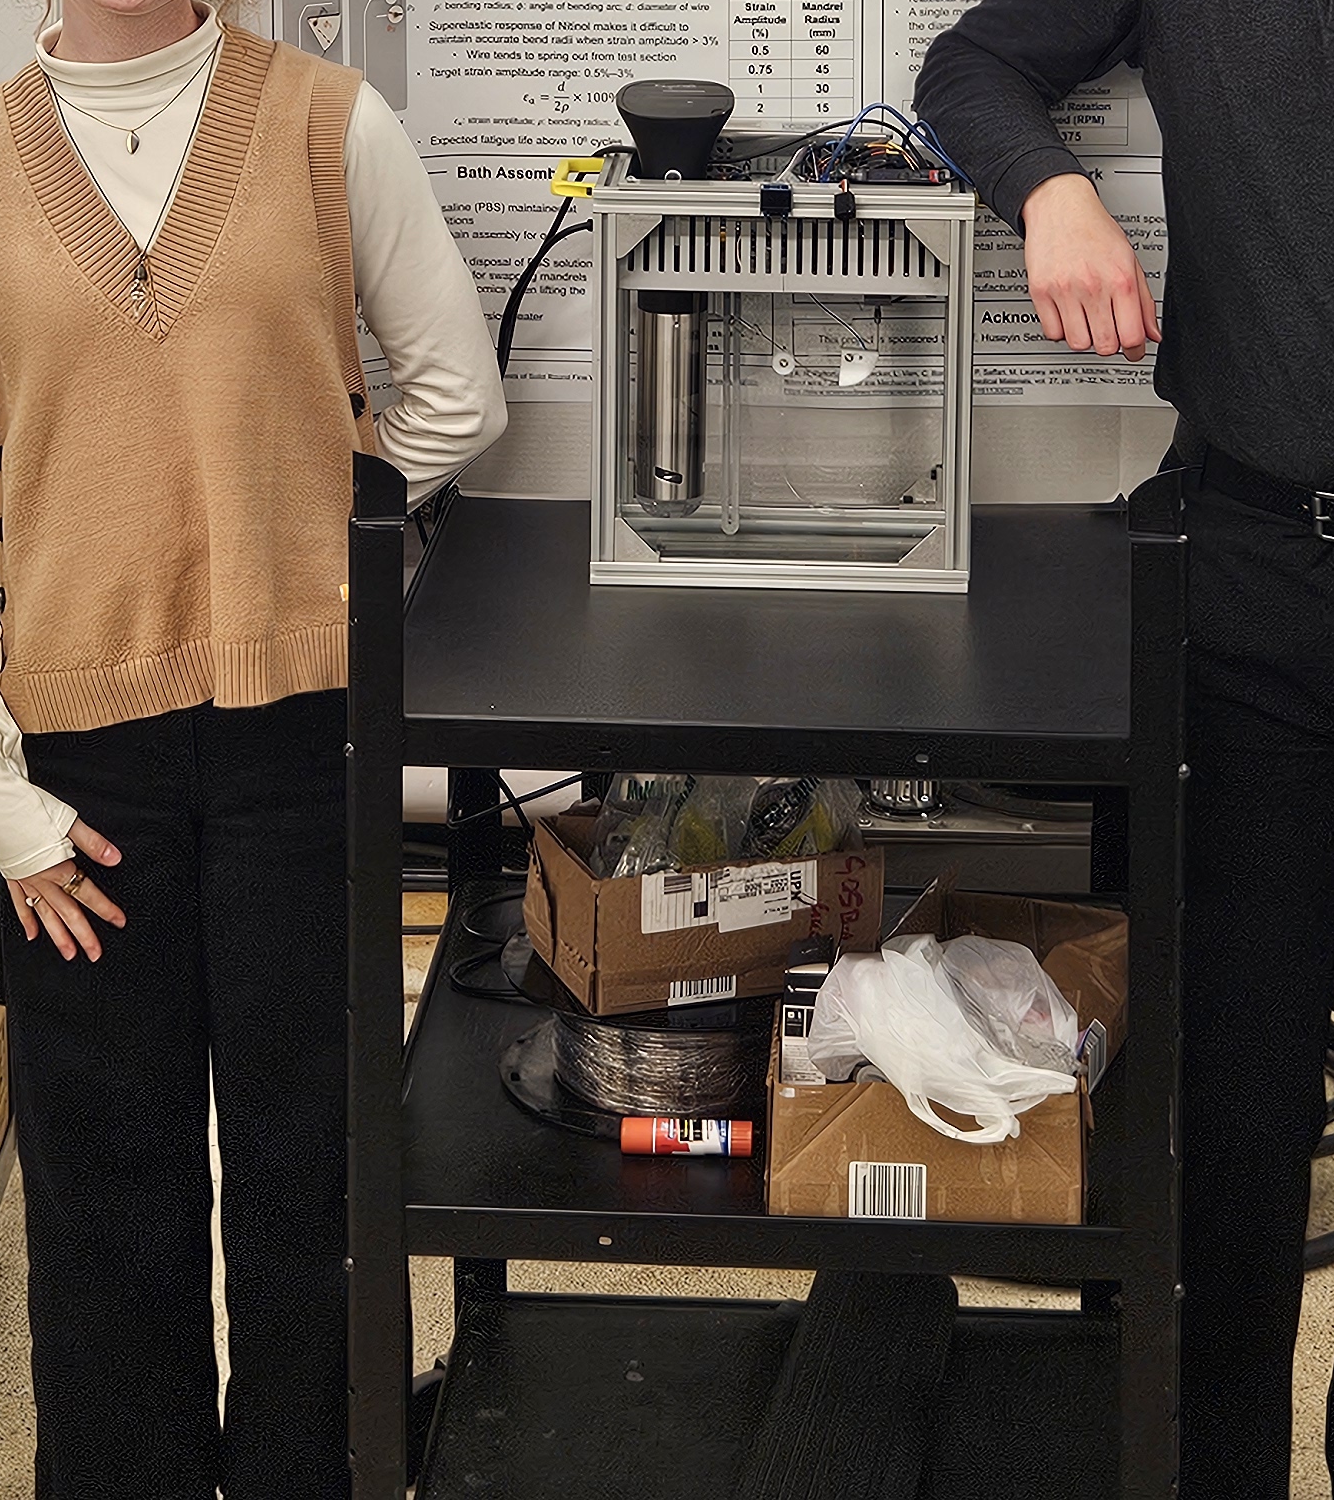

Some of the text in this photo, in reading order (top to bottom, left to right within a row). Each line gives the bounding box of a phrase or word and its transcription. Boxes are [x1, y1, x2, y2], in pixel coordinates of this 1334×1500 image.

[744, 2, 775, 10] Strain
[801, 1, 843, 9] Mandrel
[734, 16, 787, 26] Amplitude
[804, 15, 840, 23] Radius
[751, 46, 769, 55] 0.5
[815, 45, 829, 55] 60
[465, 49, 490, 58] Wire
[493, 50, 521, 58] tends
[524, 51, 534, 59] to
[537, 50, 568, 62] spring
[591, 51, 614, 60] from
[617, 52, 636, 60] test
[639, 52, 676, 60] section
[748, 65, 772, 74] 0.75
[815, 64, 829, 74] 45
[815, 83, 829, 93] 30
[757, 103, 763, 112] 2
[816, 102, 829, 112] 15
[457, 166, 491, 179] Bath
